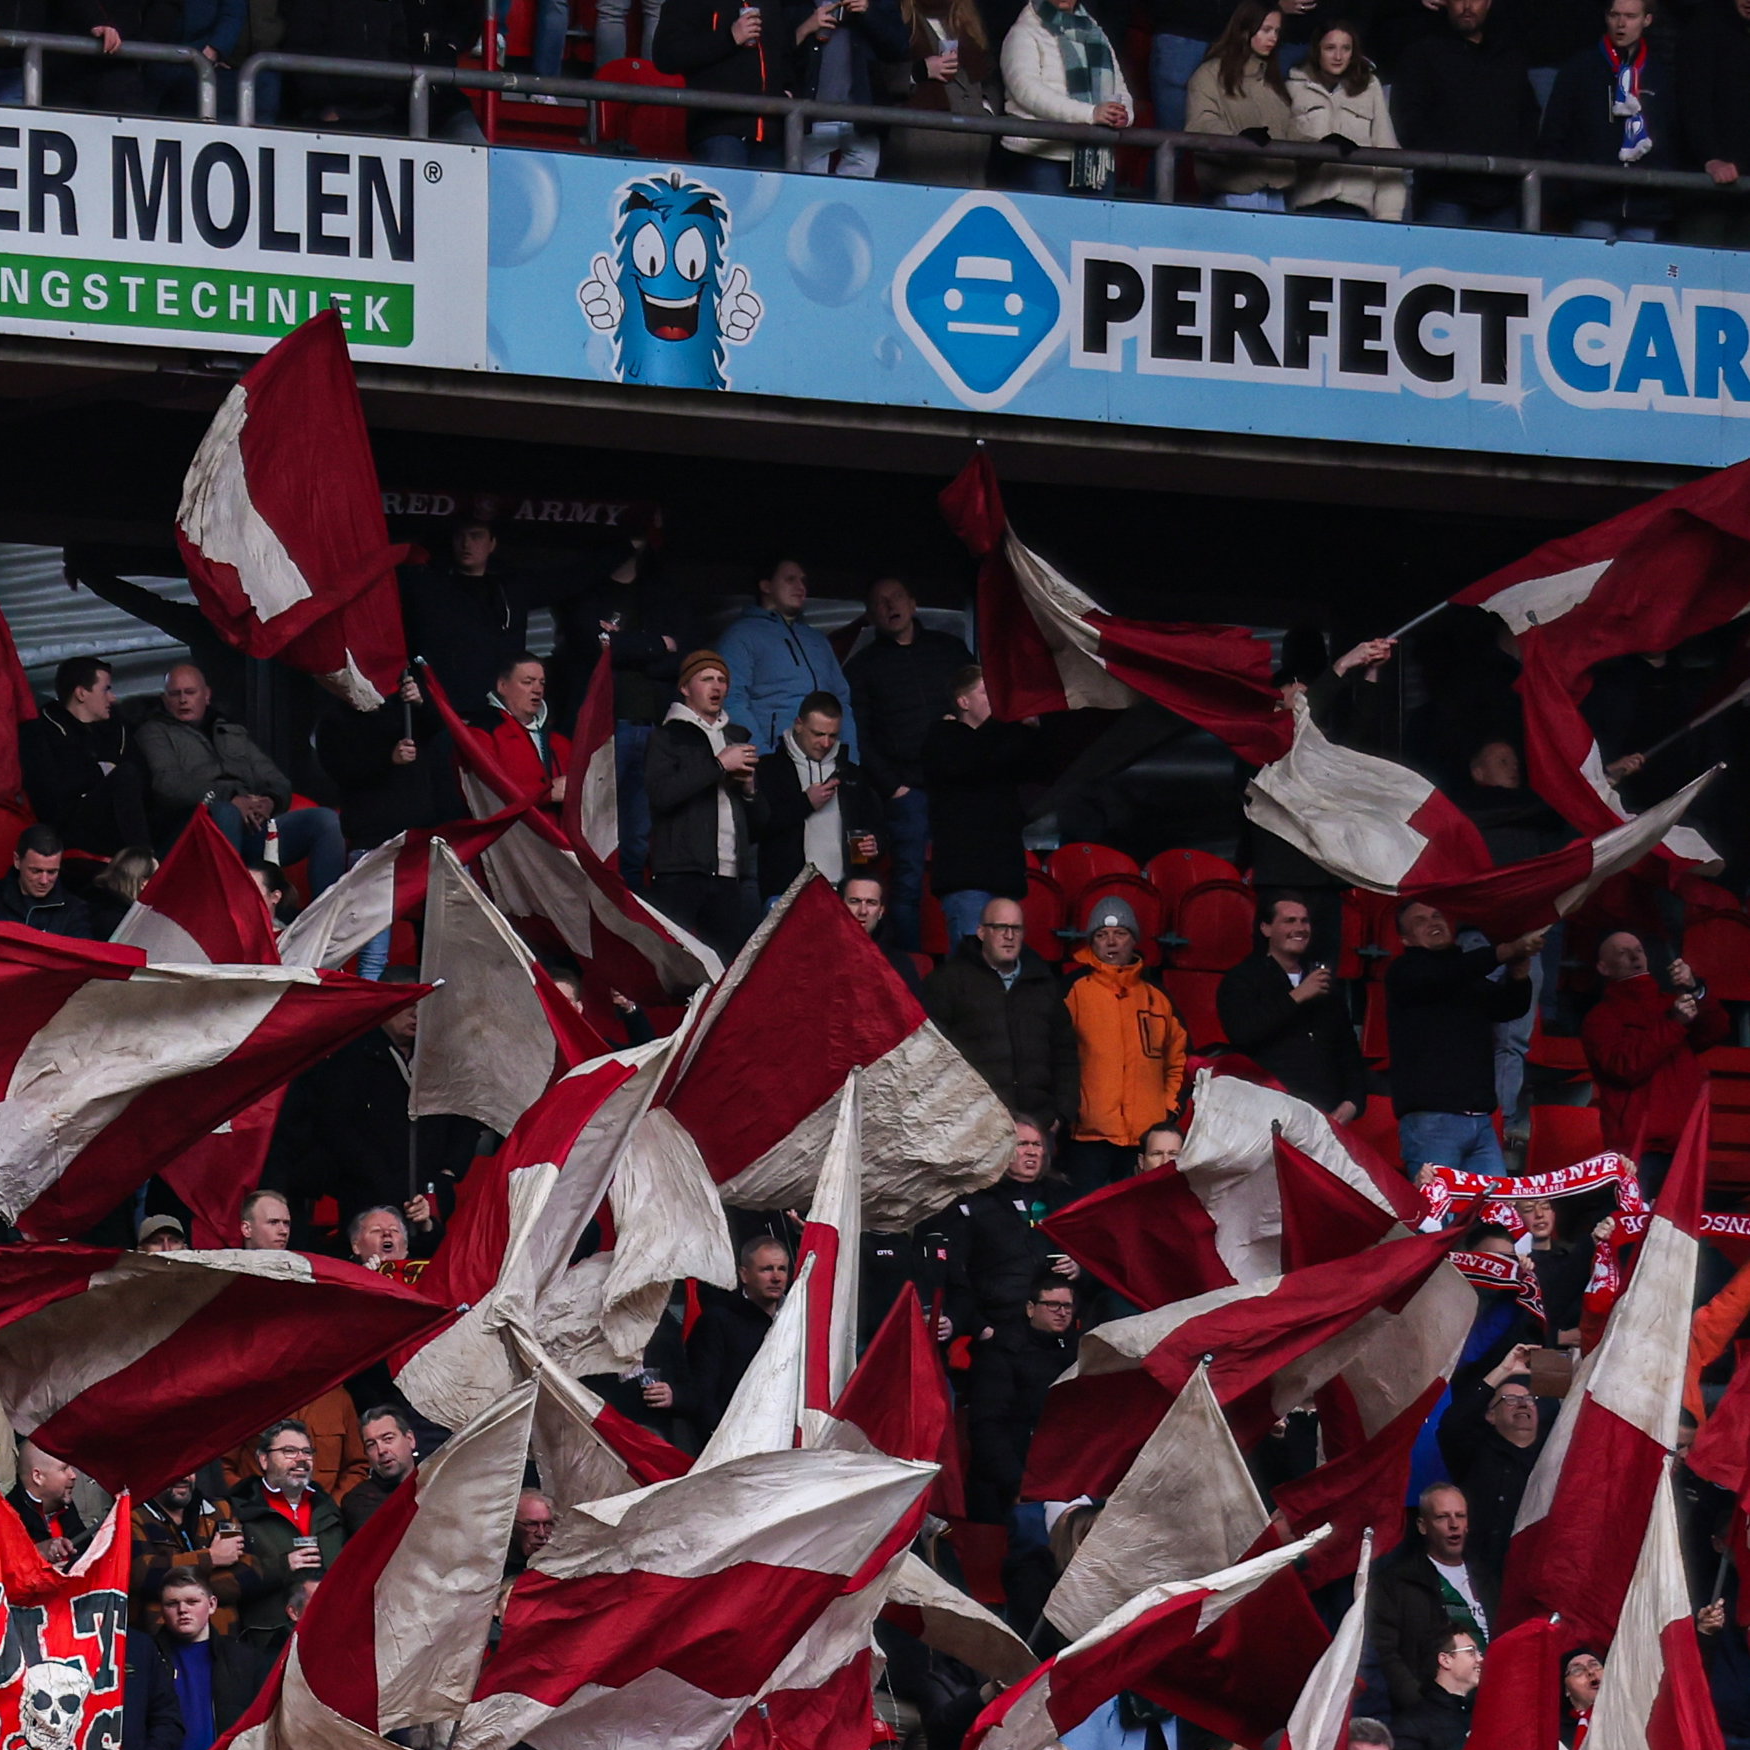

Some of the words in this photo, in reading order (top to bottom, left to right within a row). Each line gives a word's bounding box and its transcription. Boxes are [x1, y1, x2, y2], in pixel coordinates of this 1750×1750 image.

[111, 134, 415, 263] MOLEN
[513, 501, 629, 527] ARMY
[1449, 1252, 1506, 1278] ENTE
